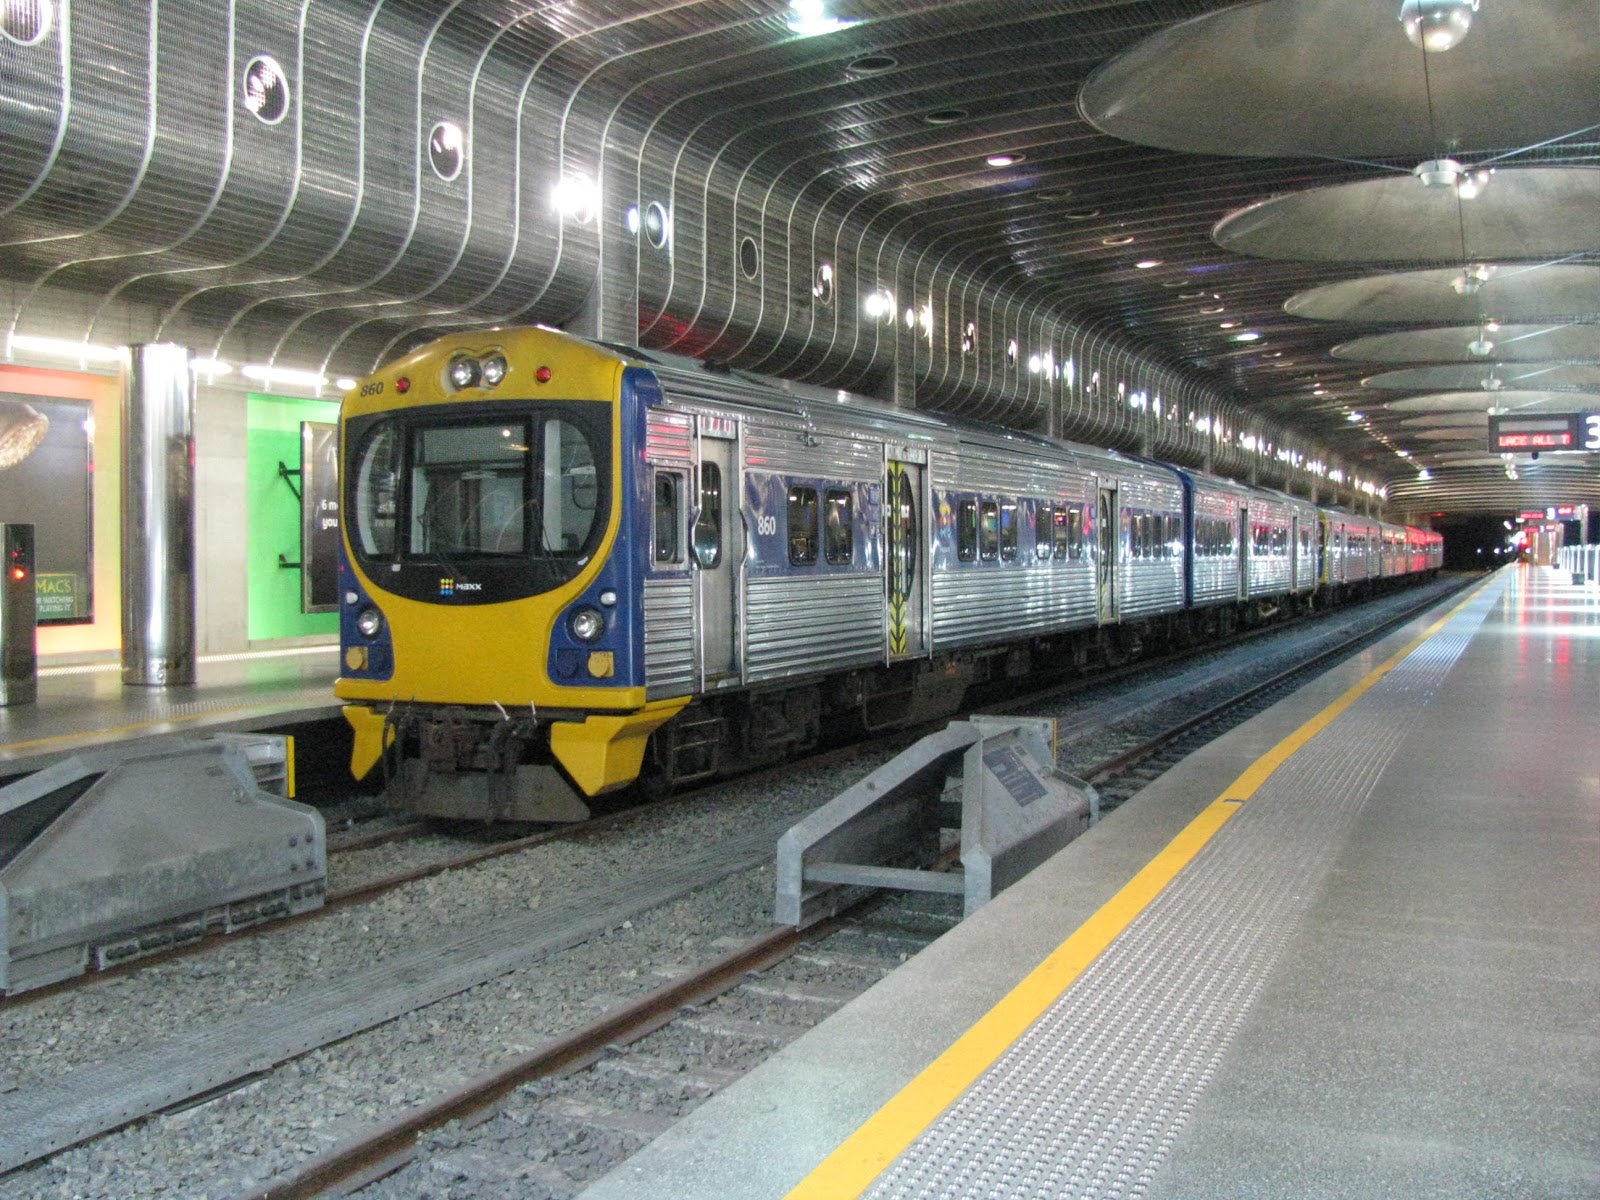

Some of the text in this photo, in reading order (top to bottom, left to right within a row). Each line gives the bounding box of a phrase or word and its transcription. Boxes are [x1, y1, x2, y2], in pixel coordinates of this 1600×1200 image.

[360, 381, 384, 397] 860
[1585, 415, 1600, 449] 3
[321, 499, 327, 510] 6
[757, 515, 776, 535] 860
